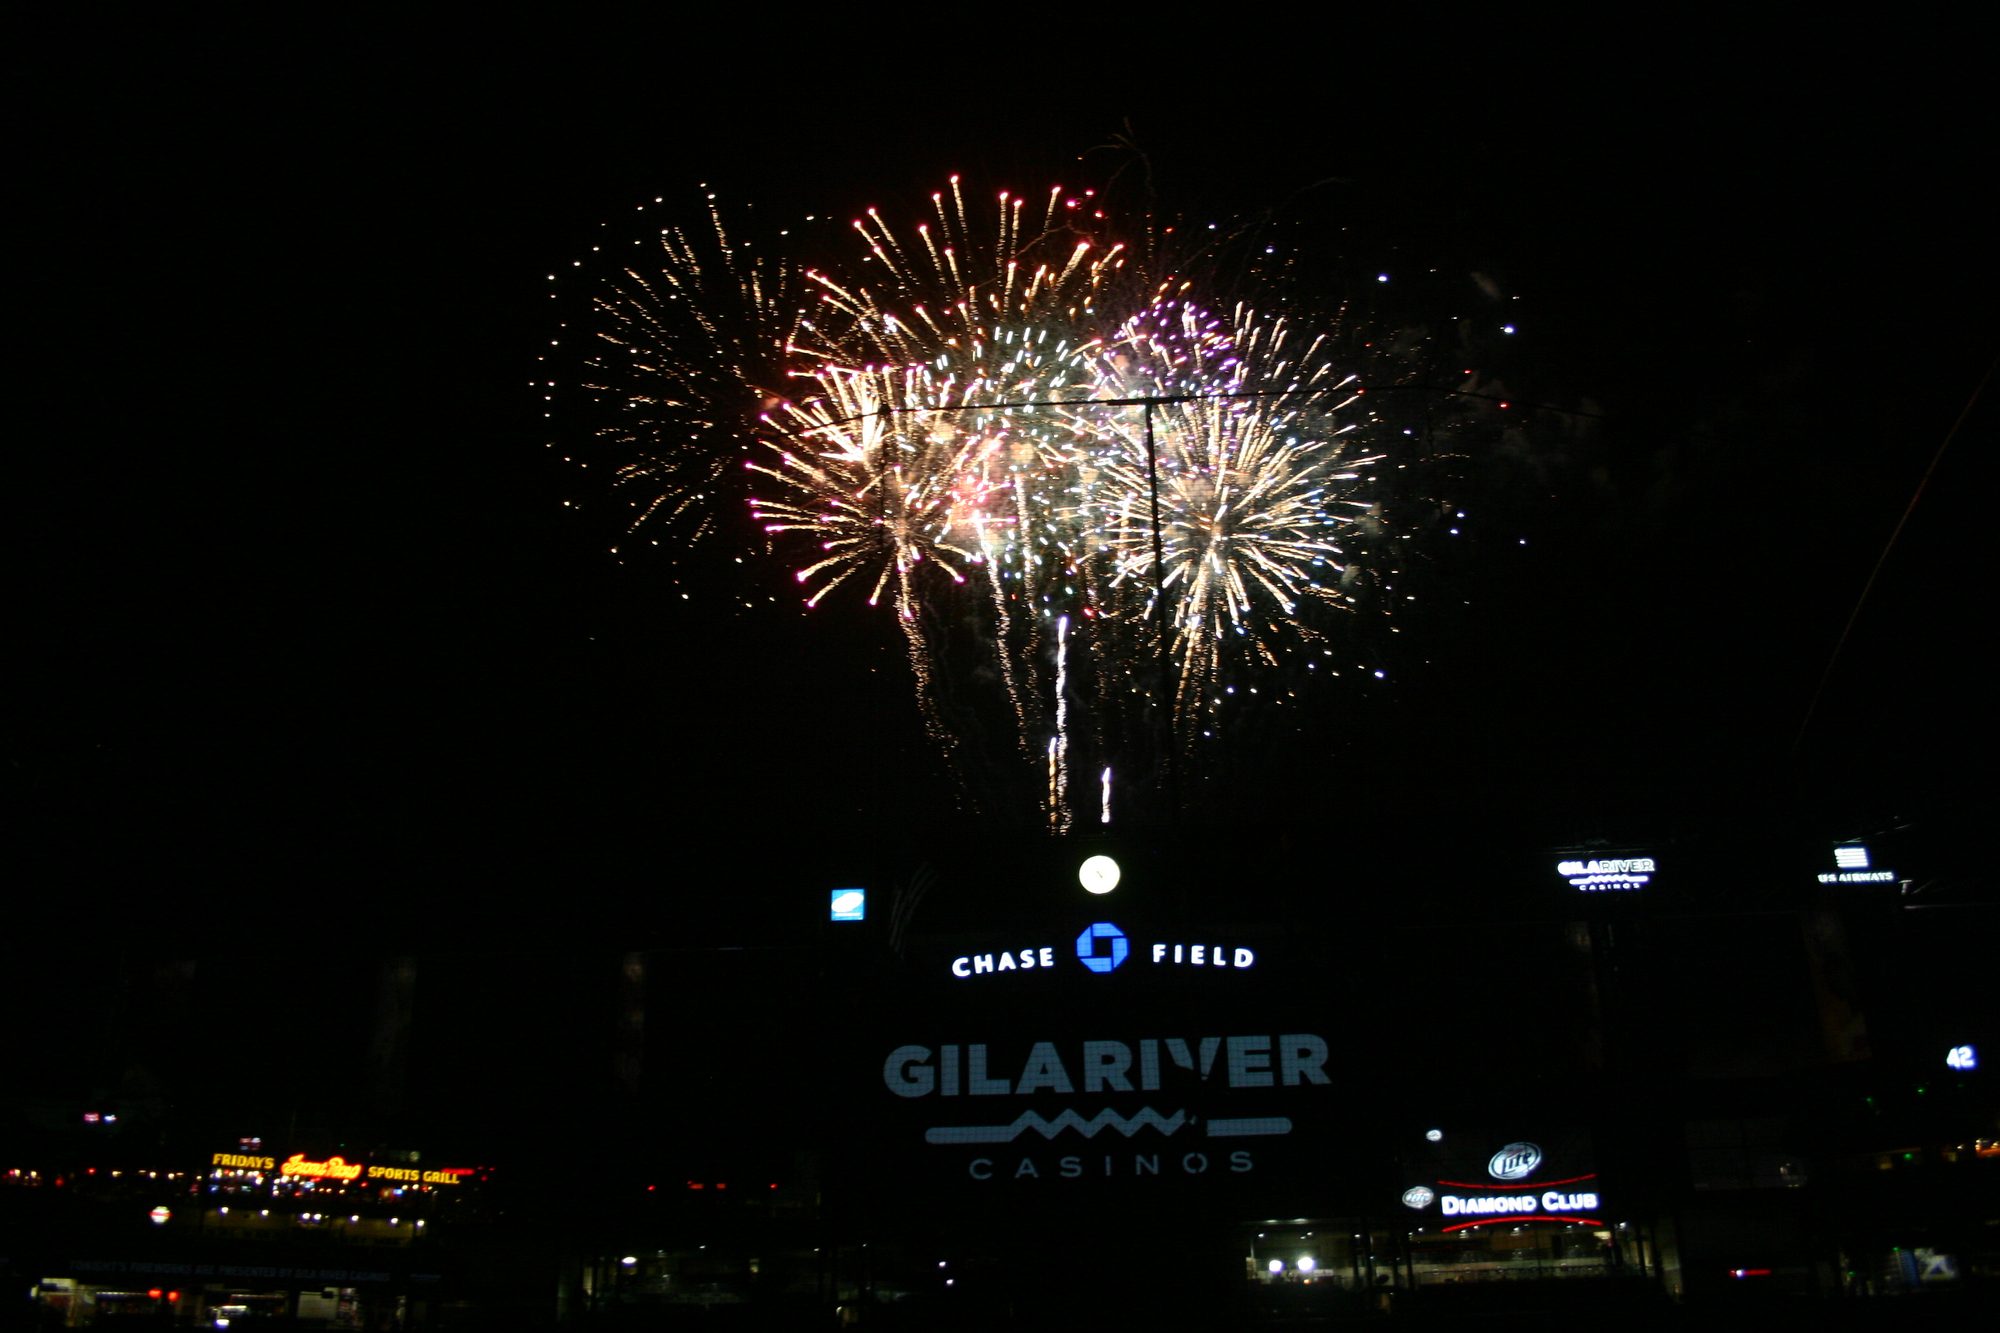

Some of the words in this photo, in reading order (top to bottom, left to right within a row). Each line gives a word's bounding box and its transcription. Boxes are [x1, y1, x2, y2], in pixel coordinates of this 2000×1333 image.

[1577, 882, 1640, 891] CASINOS
[1817, 873, 1837, 883] US
[1839, 871, 1894, 882] AIRWAYS
[952, 947, 1054, 977] CHASE
[1152, 944, 1254, 968] FIELD
[1946, 1045, 1975, 1070] 42
[367, 1165, 420, 1181] SPORTS
[422, 1170, 460, 1184] GRILL
[969, 1151, 1253, 1180] CASINOS
[1441, 1195, 1537, 1215] DIAMOND
[1541, 1191, 1599, 1212] CLUB
